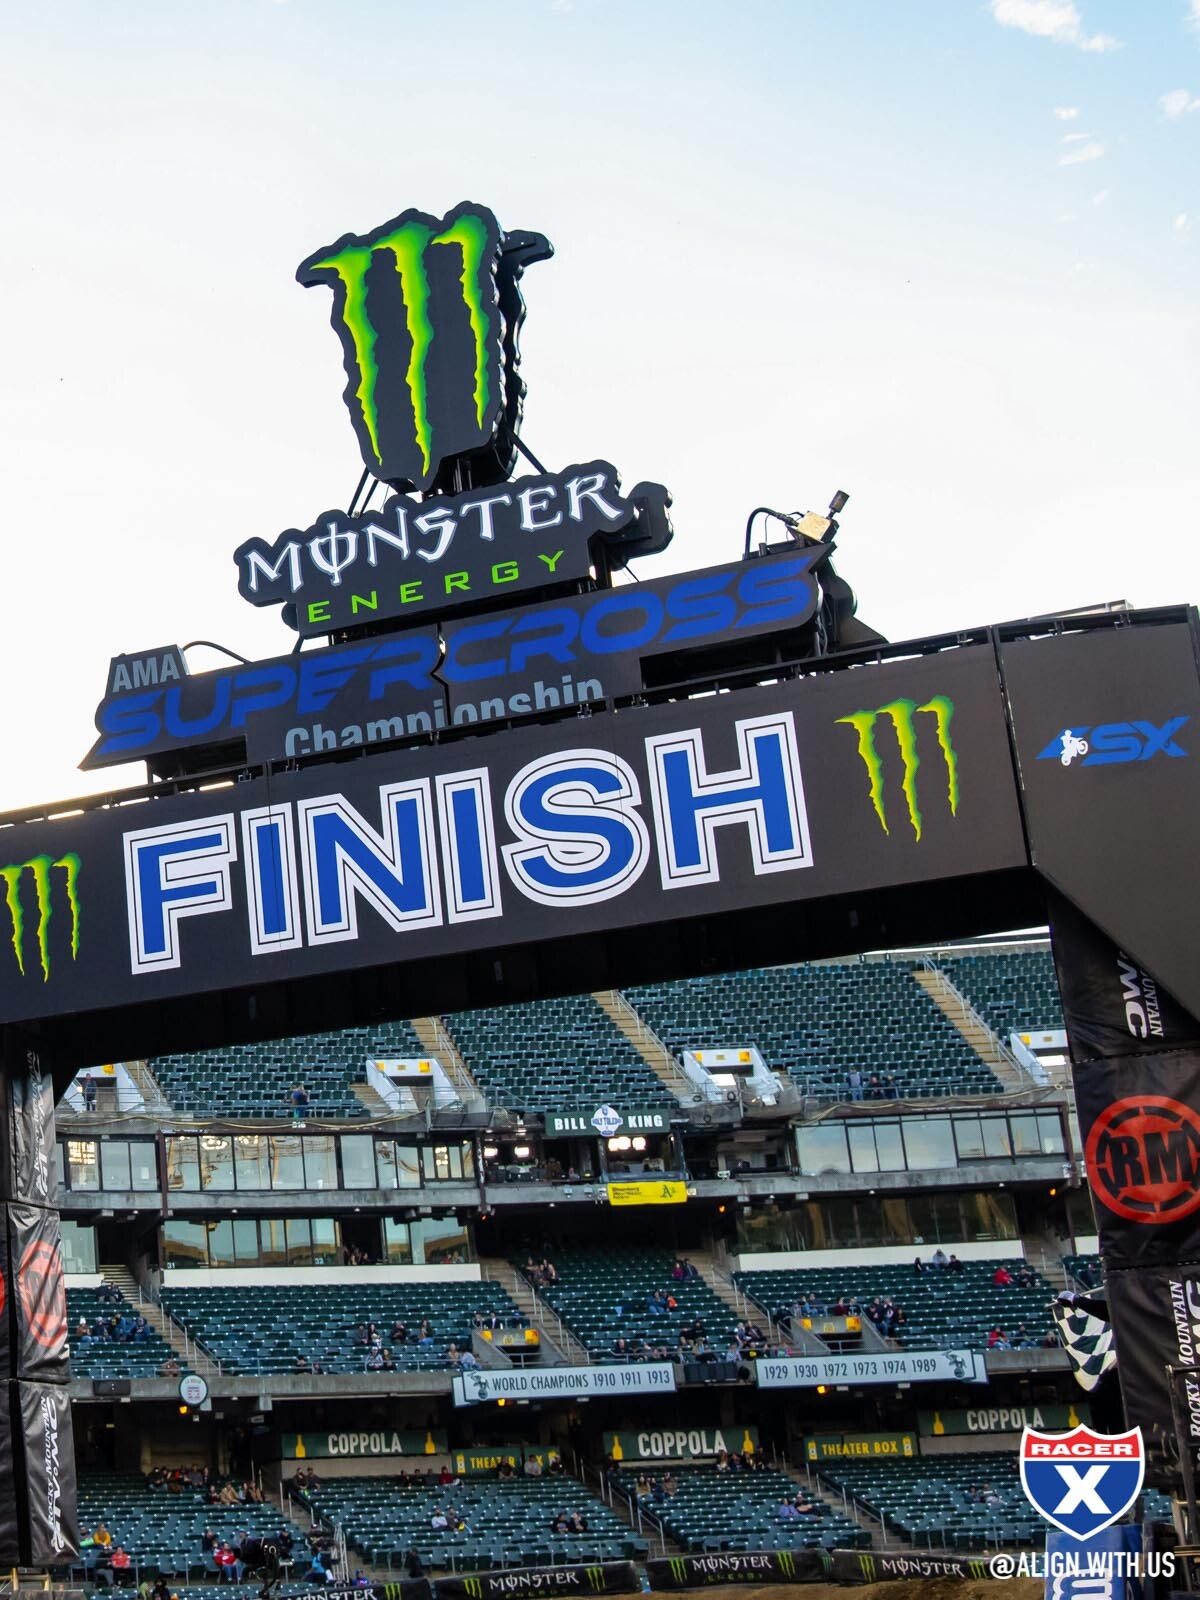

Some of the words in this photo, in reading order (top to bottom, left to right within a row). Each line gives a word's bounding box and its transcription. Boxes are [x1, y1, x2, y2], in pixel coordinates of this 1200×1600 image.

[247, 472, 623, 593] MONSTER
[307, 550, 565, 623] ENERGY
[95, 556, 815, 757] SUPERCROSS
[112, 653, 180, 693] AMA
[121, 710, 815, 975] FINISH
[554, 1116, 587, 1131] BILL
[627, 1114, 663, 1129] KING
[1109, 1129, 1198, 1189] RM
[492, 1376, 528, 1392] WORLD
[530, 1373, 589, 1390] CHAMPIONS
[593, 1372, 616, 1388] 1910
[620, 1371, 642, 1387] 1911
[647, 1369, 671, 1385] 1913
[763, 1364, 788, 1380] 1929
[793, 1363, 818, 1379] 1930
[823, 1362, 848, 1378] 1972
[852, 1361, 878, 1377] 1973
[882, 1359, 907, 1375] 1974
[911, 1358, 937, 1374] 1989
[966, 1407, 1044, 1431] COPPOLA
[41, 1396, 53, 1476] MOUNTAIN
[328, 1432, 403, 1455] COPPOLA
[638, 1430, 728, 1457] COPPOLA
[821, 1442, 870, 1456] THEATER
[874, 1440, 899, 1454] BOX
[469, 1455, 515, 1470] THEATR
[692, 1555, 773, 1574] MONSTER
[881, 1557, 965, 1578] MONSTER
[488, 1571, 580, 1591] MONSTER
